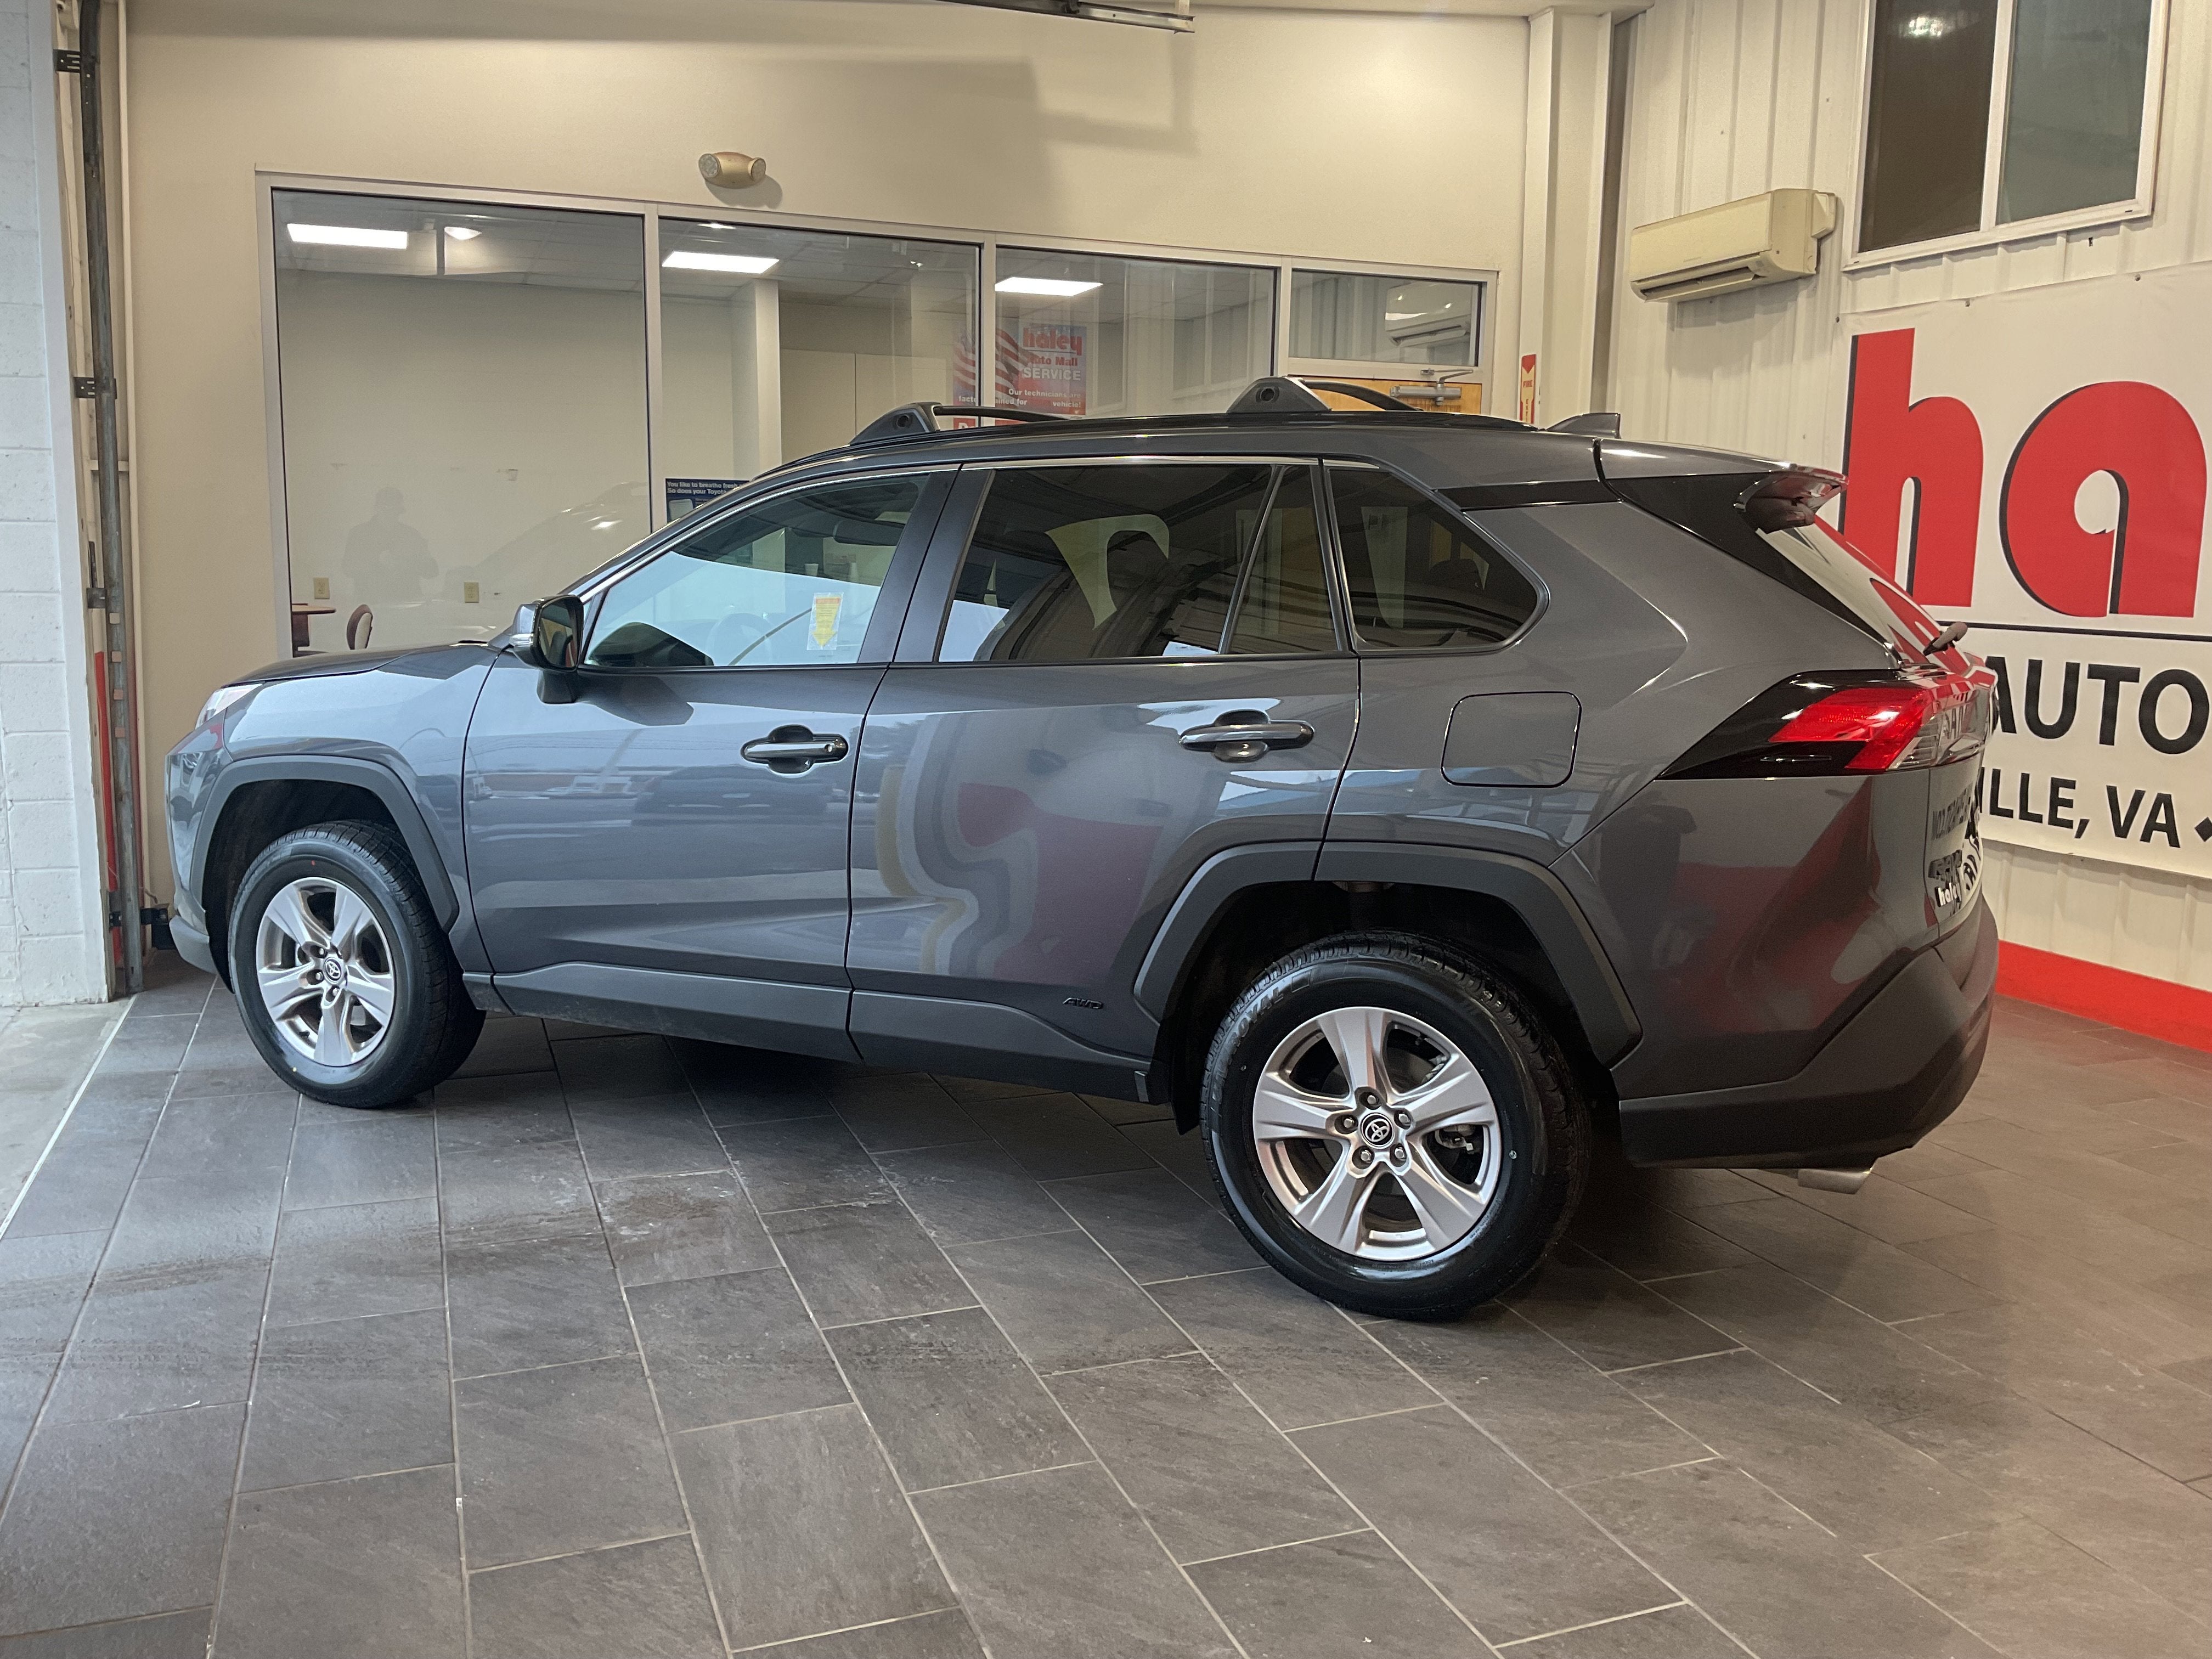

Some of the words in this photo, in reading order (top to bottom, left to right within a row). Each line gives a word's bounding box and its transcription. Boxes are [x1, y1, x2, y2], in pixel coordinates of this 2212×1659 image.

[1023, 328, 1082, 356] haley
[1023, 367, 1081, 381] SERVICE
[1056, 357, 1077, 366] Mall
[1025, 389, 1067, 398] technicians
[1838, 328, 2207, 617] ha
[1986, 656, 2210, 754] AUTO
[2106, 785, 2181, 849] VA
